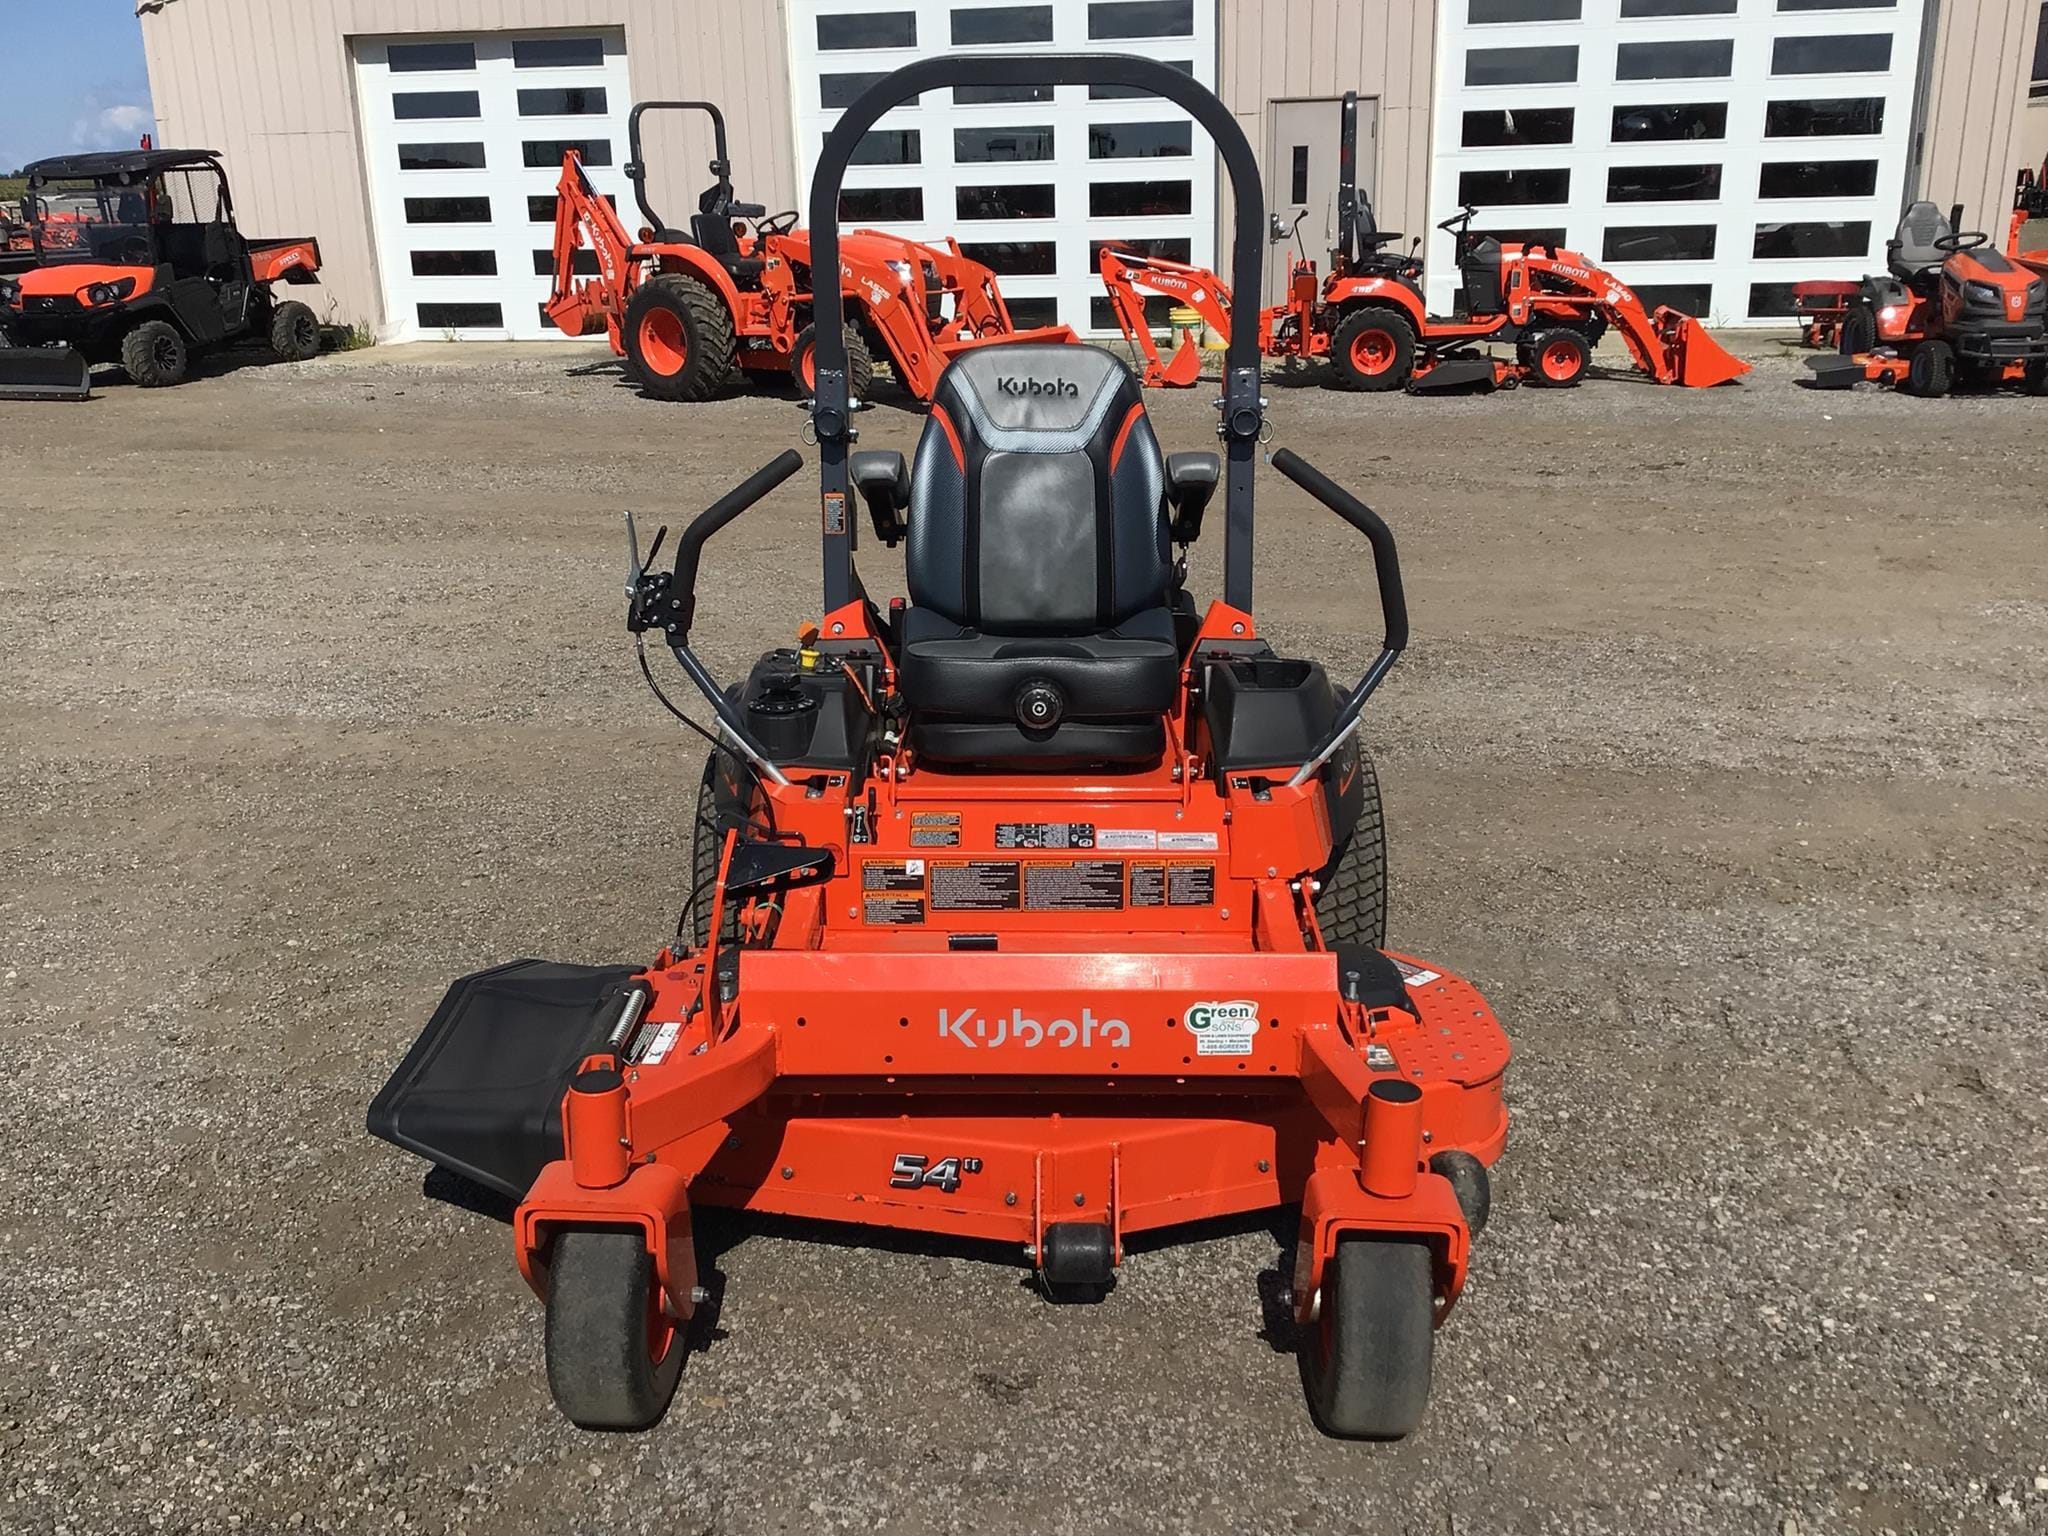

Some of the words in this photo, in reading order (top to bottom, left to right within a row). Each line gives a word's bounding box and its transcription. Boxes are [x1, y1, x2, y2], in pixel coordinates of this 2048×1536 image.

[1550, 262, 1591, 280] KUBOTA
[1151, 275, 1188, 290] KUBOTA
[1603, 277, 1633, 302] LA340
[997, 376, 1079, 397] Kubota
[938, 1008, 1130, 1048] Kubota
[1189, 1007, 1249, 1029] Green
[1211, 1023, 1242, 1032] SONS
[889, 1153, 983, 1193] 54"
